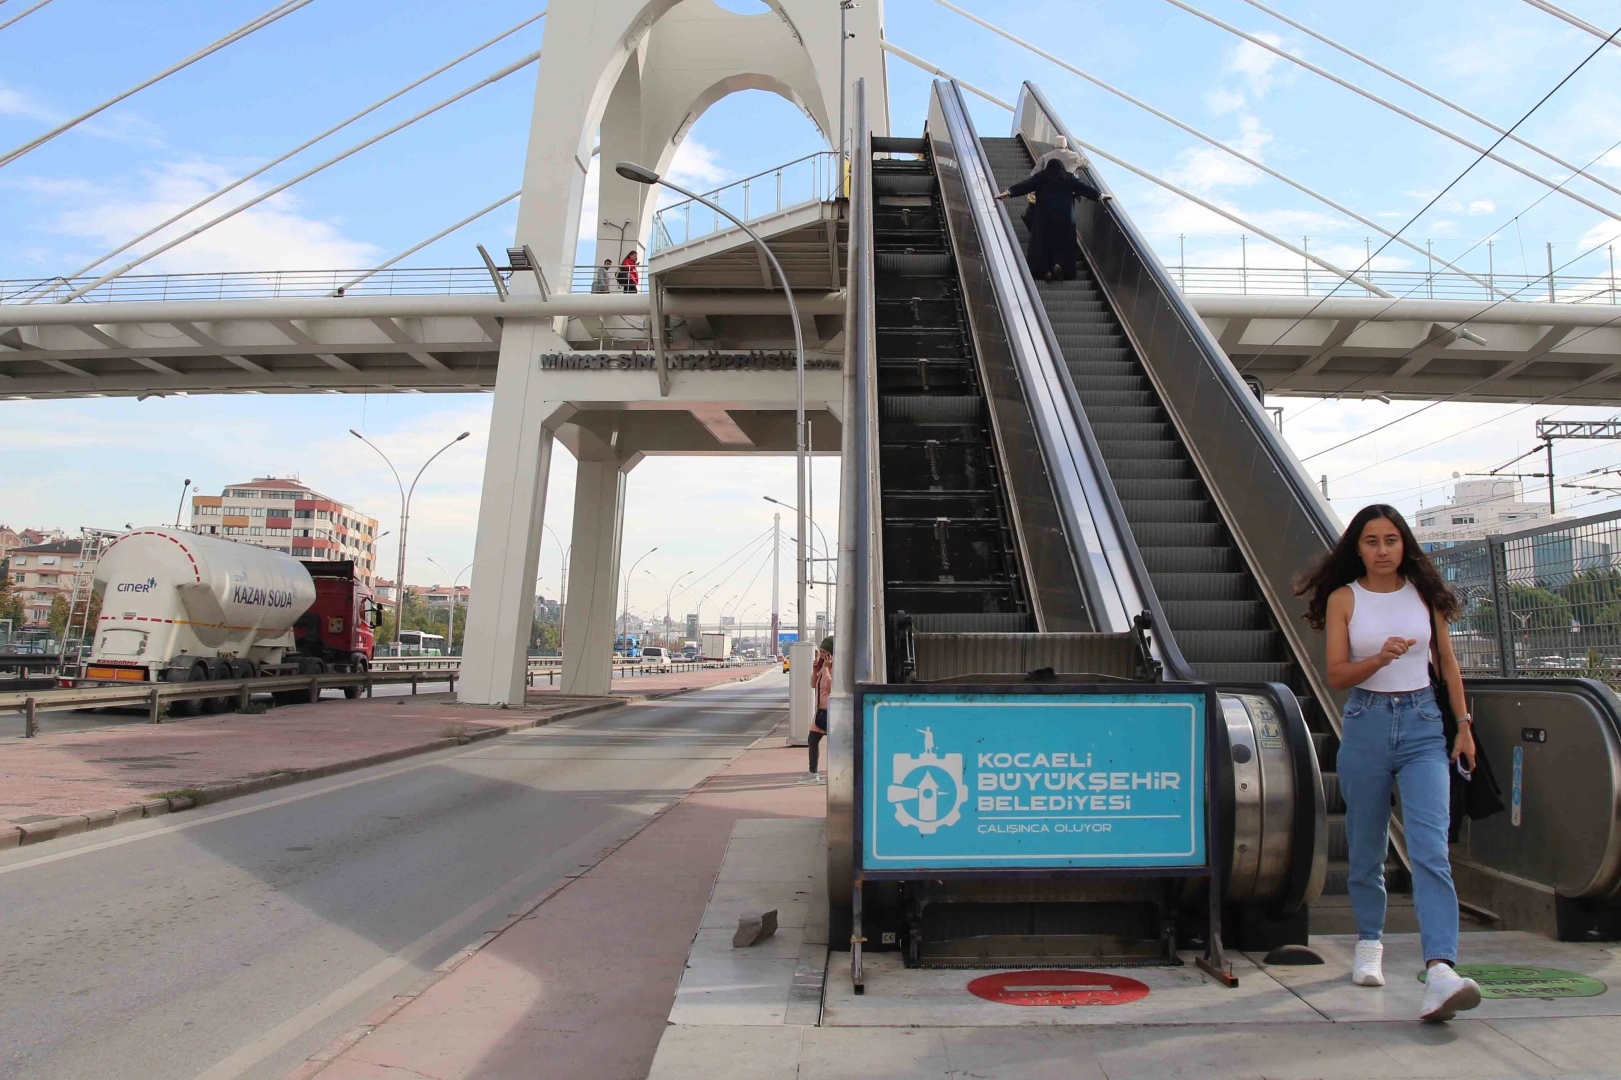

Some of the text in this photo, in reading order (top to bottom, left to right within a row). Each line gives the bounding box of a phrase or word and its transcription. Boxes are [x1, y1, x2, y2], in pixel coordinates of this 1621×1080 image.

[540, 351, 610, 370] MİMAR
[617, 350, 683, 370] SİNN
[688, 350, 795, 370] KÖPRÜSÜ
[233, 584, 292, 609] KAZAN SODA
[977, 752, 1092, 768] KOCAELİ
[977, 771, 1181, 793] BÜYÜKŞEHİR
[977, 794, 1131, 812] BELEDİYESİ
[977, 823, 1112, 835] ÇALIŞINCA OLUYOR
